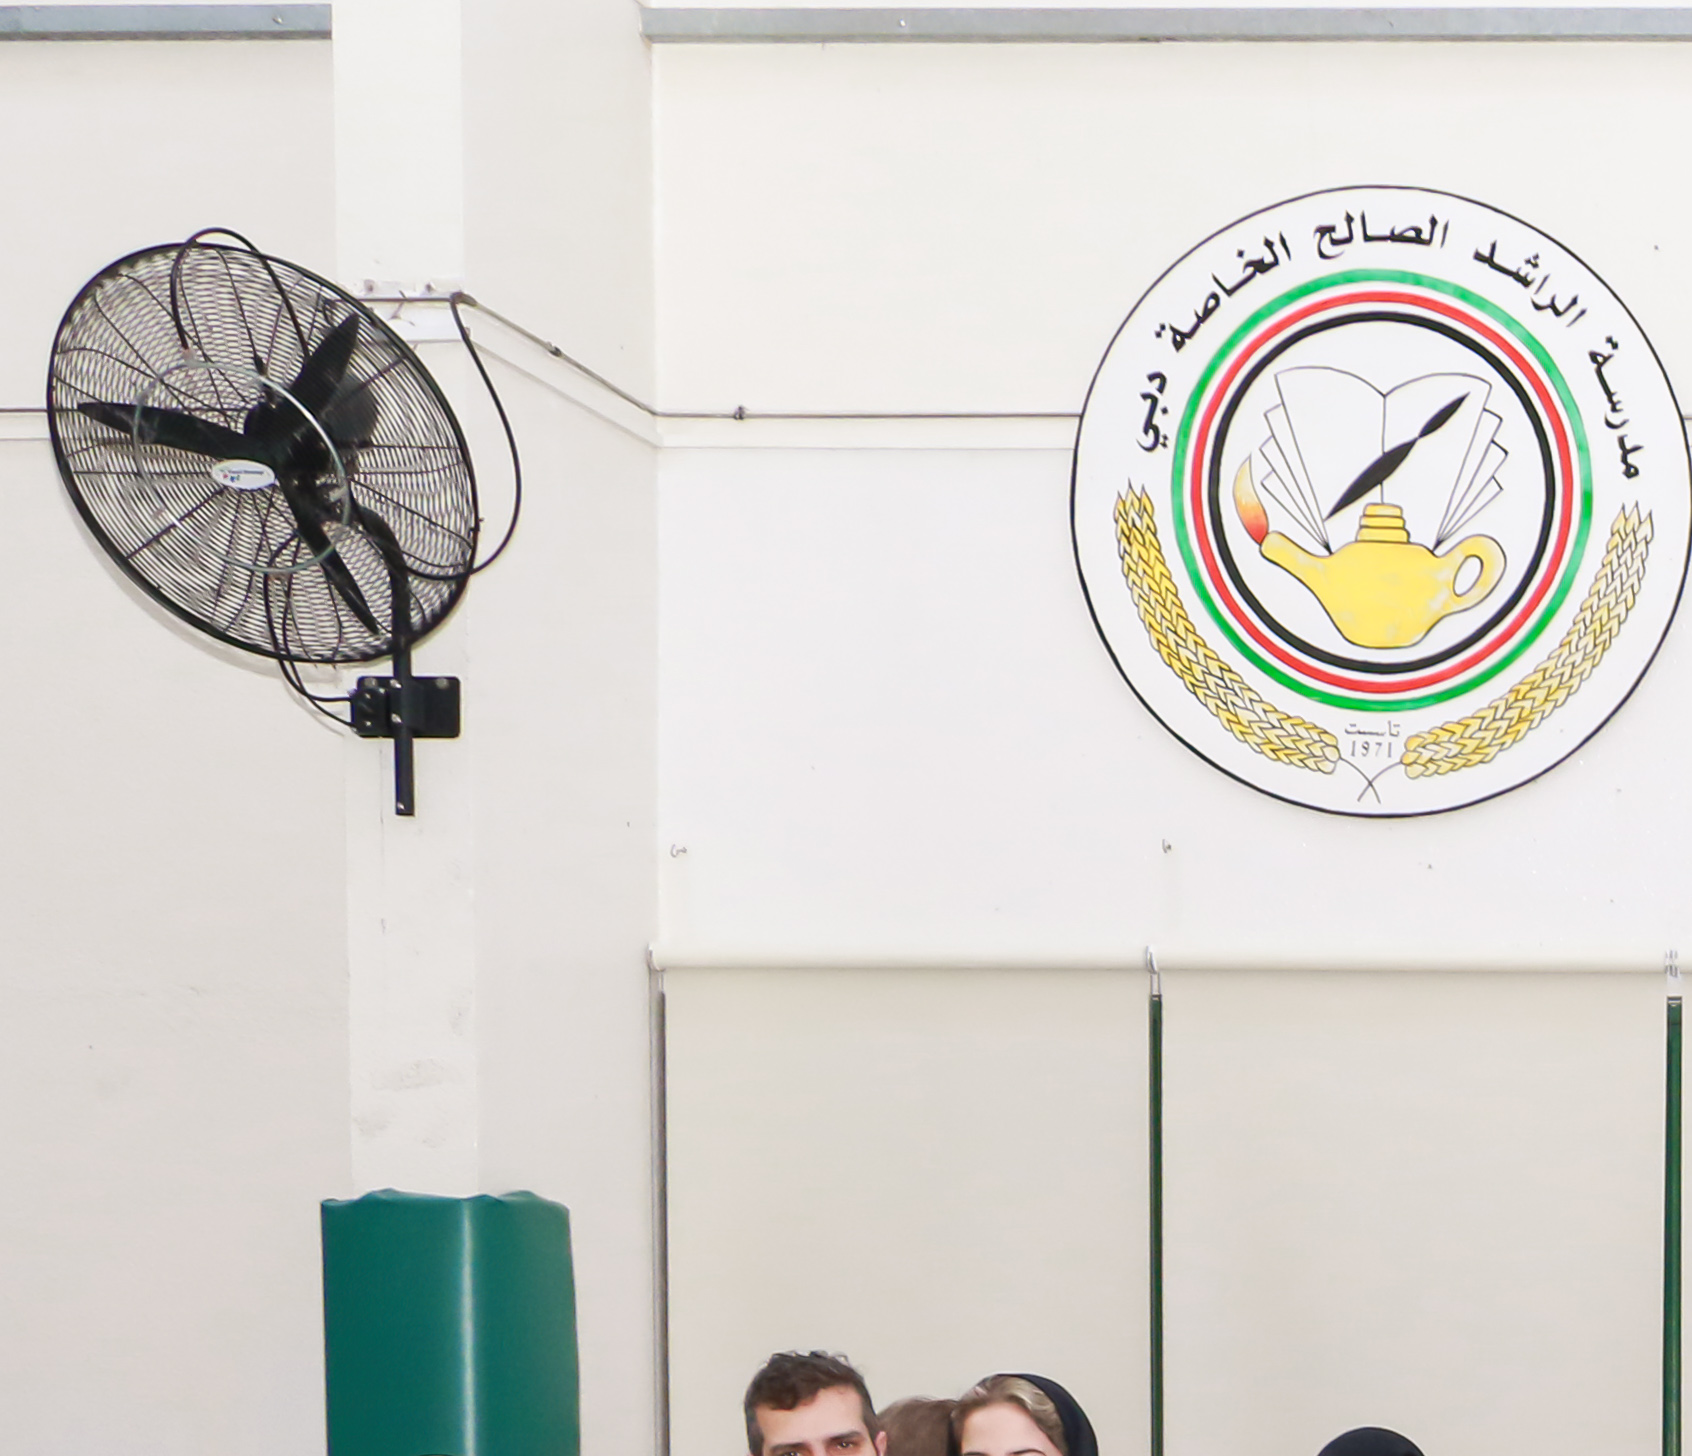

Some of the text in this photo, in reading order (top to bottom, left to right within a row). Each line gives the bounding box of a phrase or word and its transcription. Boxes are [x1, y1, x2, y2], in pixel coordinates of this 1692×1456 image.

[1136, 209, 1644, 480] مدرسة الراشد الصالح الخاصة دبي
[1350, 740, 1392, 758] 1971
